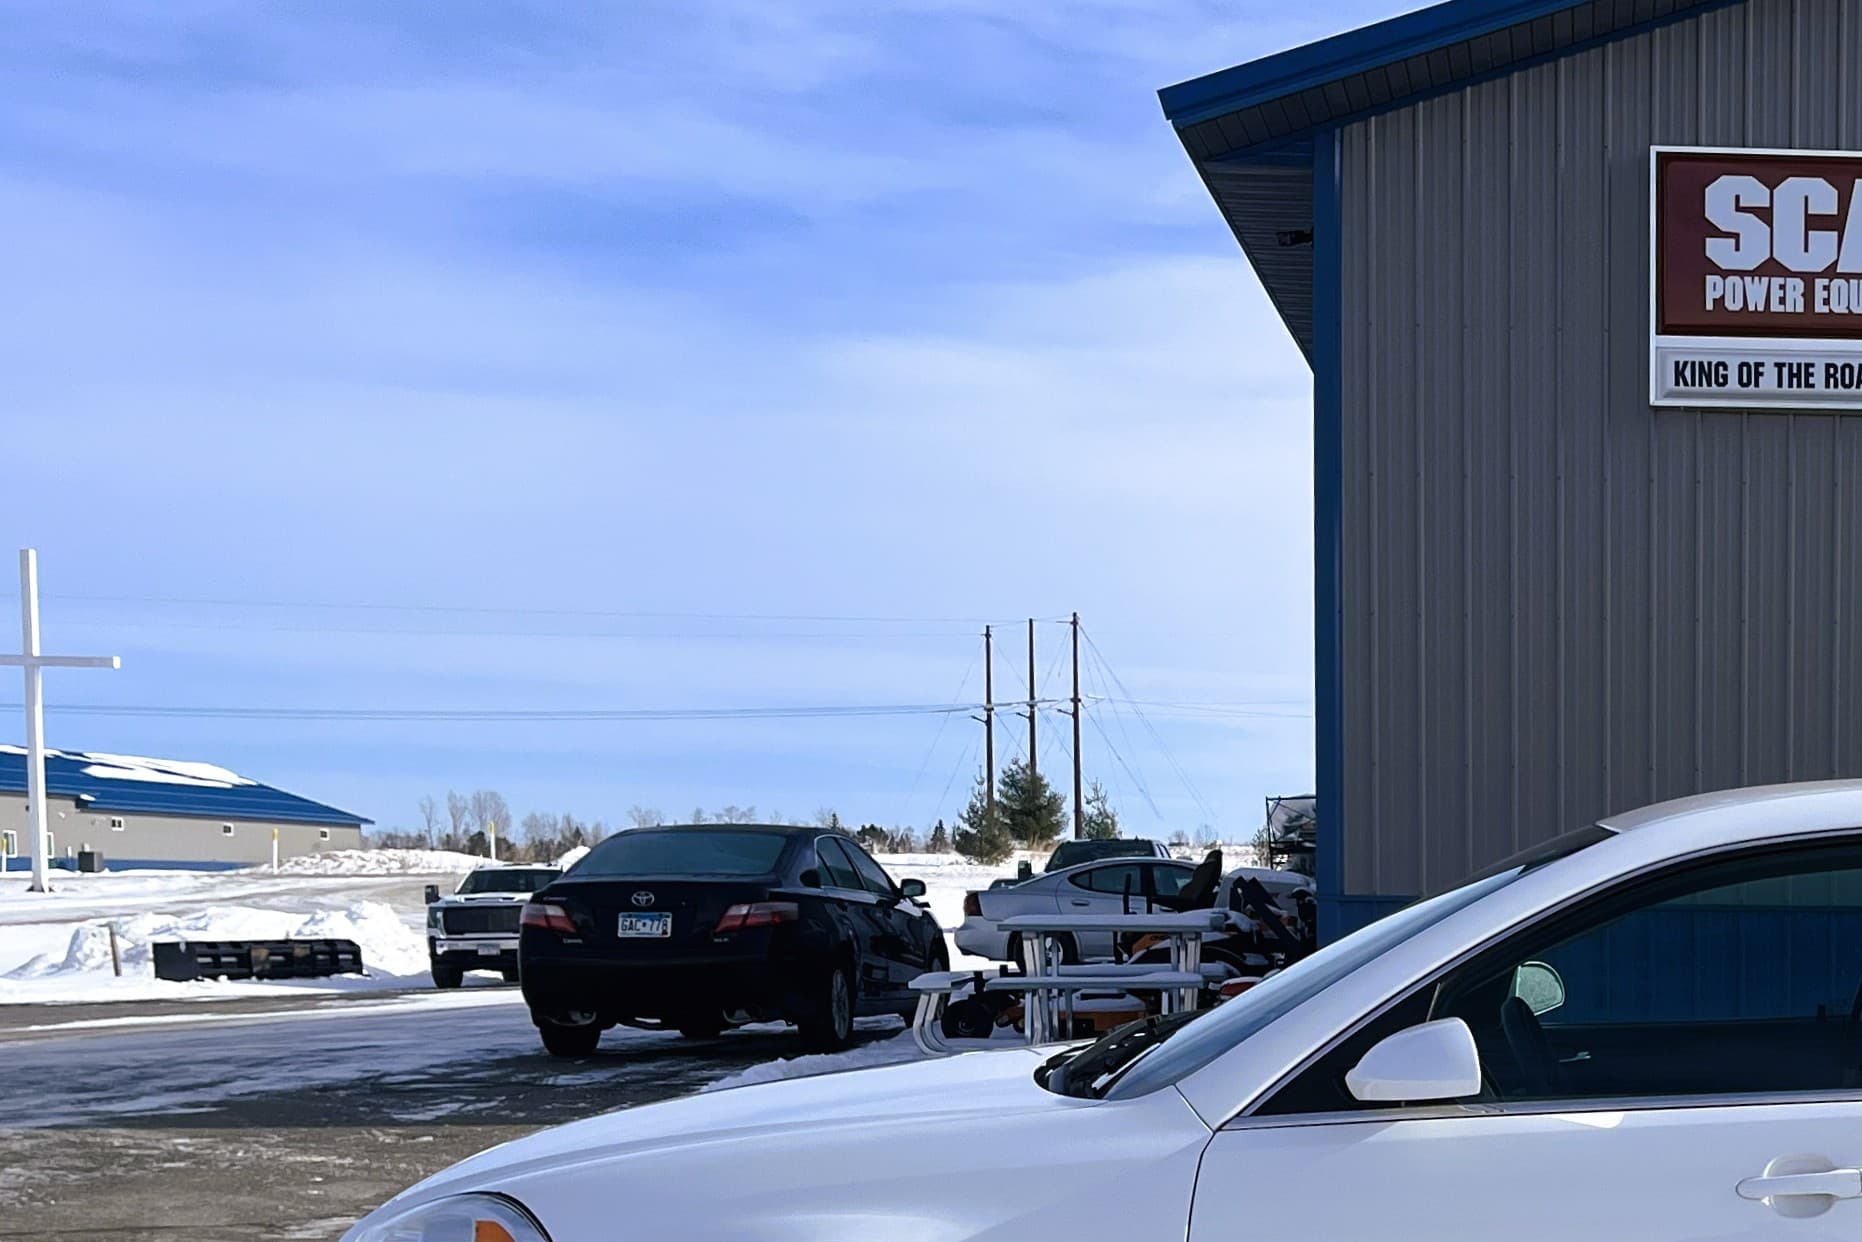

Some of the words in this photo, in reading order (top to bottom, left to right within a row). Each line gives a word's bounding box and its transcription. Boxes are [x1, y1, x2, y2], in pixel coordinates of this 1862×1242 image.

[1705, 274, 1804, 313] POWER
[1674, 360, 1729, 388] KING
[1737, 361, 1765, 388] OF
[1774, 361, 1815, 389] THE
